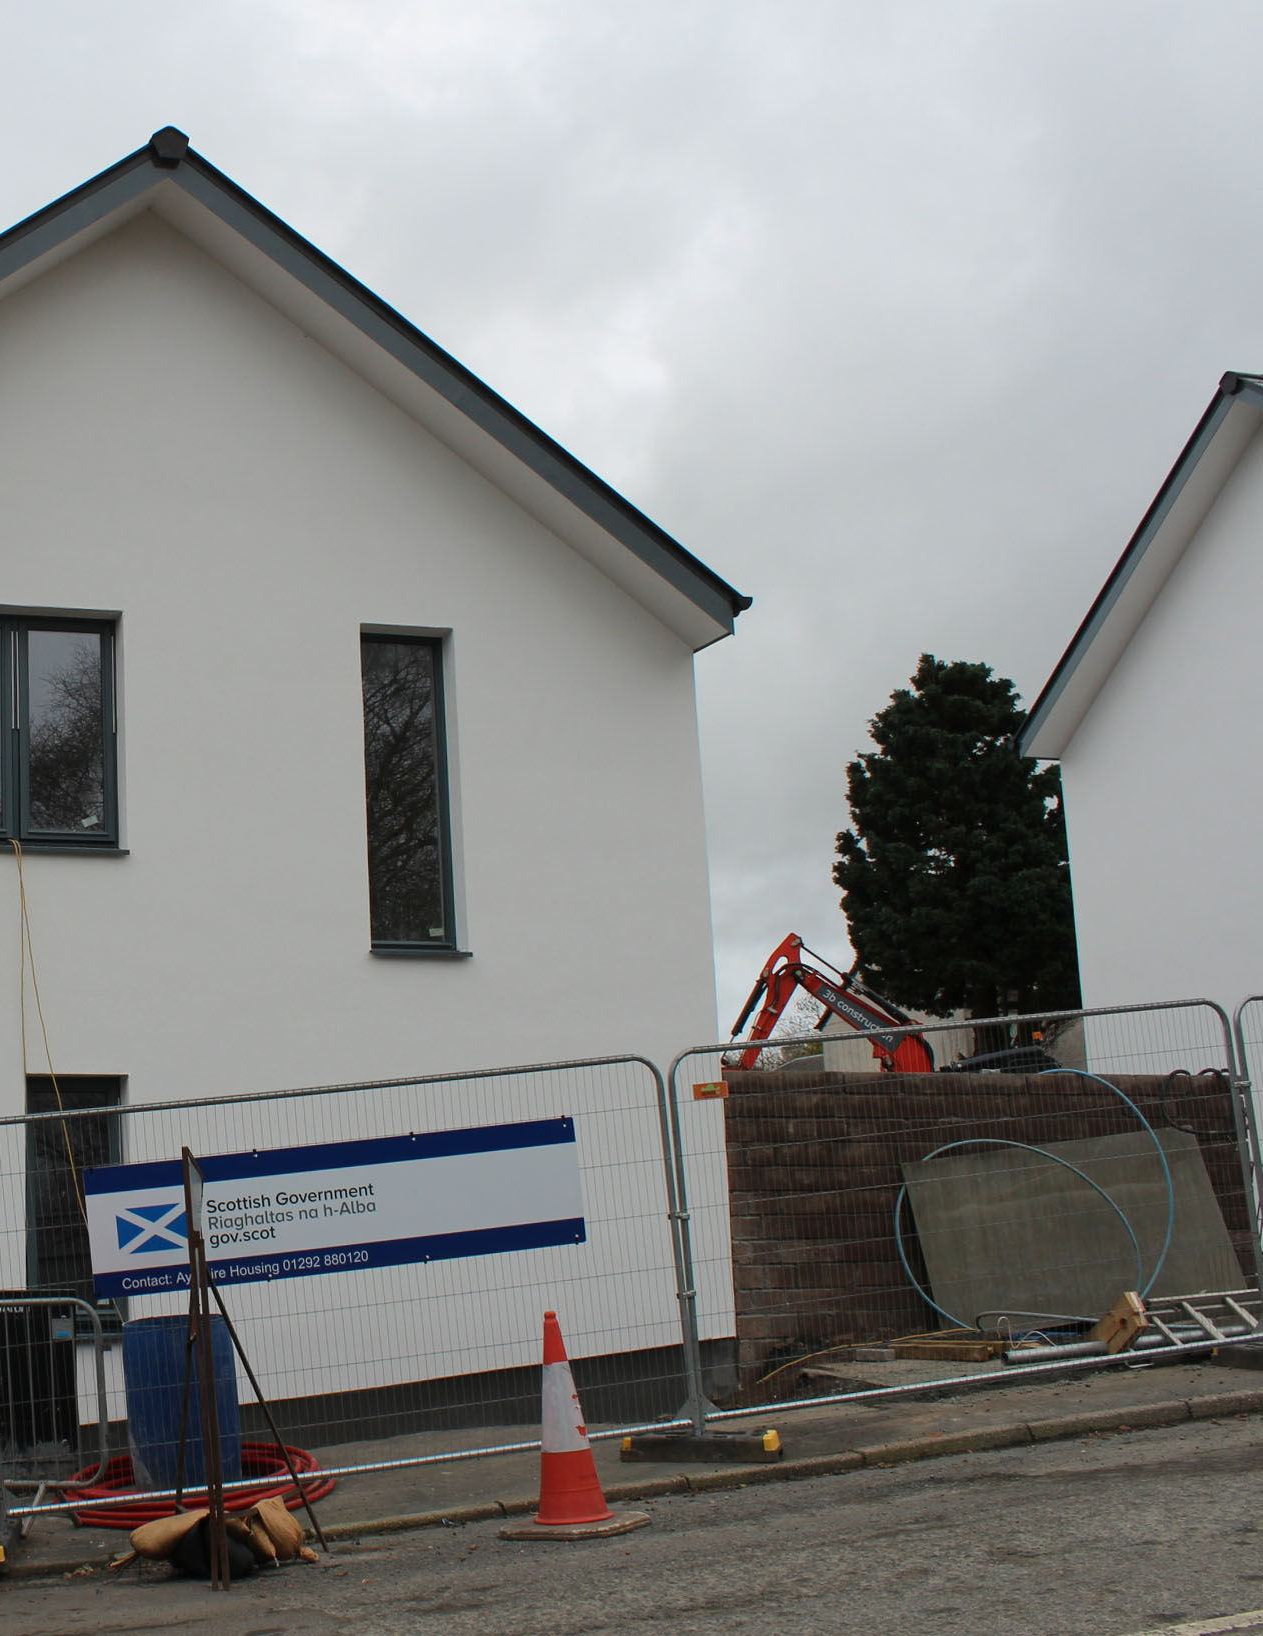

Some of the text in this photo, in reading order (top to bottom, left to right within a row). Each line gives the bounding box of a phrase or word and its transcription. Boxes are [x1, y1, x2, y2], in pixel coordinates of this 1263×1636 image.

[821, 989, 836, 1002] 3b
[206, 1183, 374, 1213] Scottish Government
[208, 1200, 376, 1230] Riaghaltas na h-Alba
[209, 1226, 276, 1248] gov.scot
[121, 1250, 369, 1289] Contact: Ayire Housing 01292 880120
